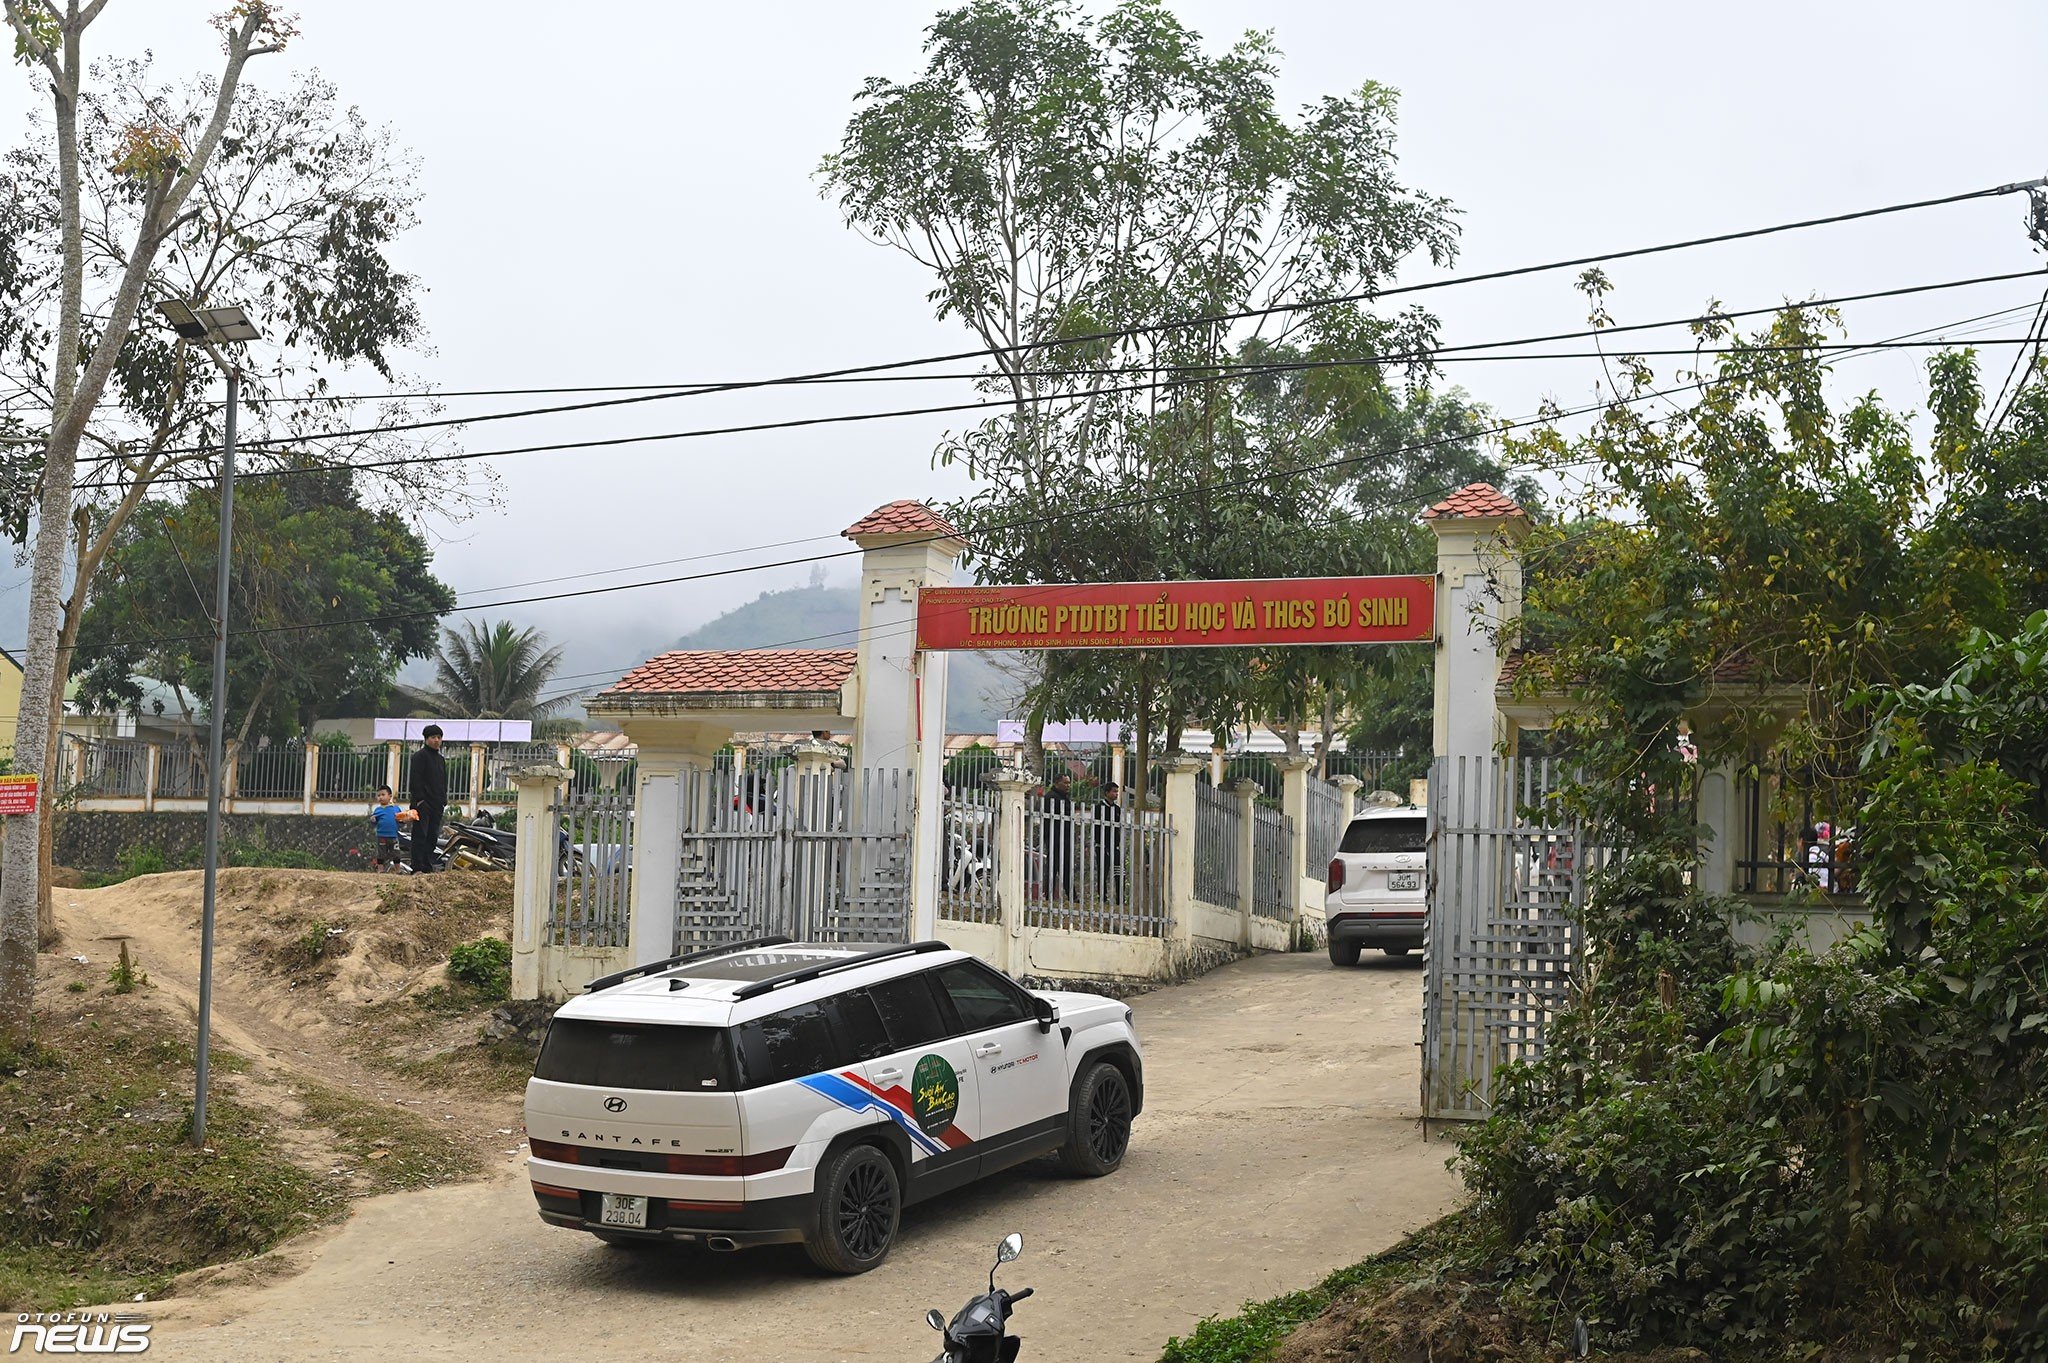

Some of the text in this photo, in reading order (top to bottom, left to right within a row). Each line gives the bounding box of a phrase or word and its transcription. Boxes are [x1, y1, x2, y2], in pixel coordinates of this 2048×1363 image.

[968, 592, 1408, 636] TRƯỜNG PTDTBT TIỂU HỌC VÀ THCS BÓ SINH
[1164, 636, 1174, 644] LA
[615, 1197, 635, 1210] 30E
[605, 1210, 641, 1225] 238.04
